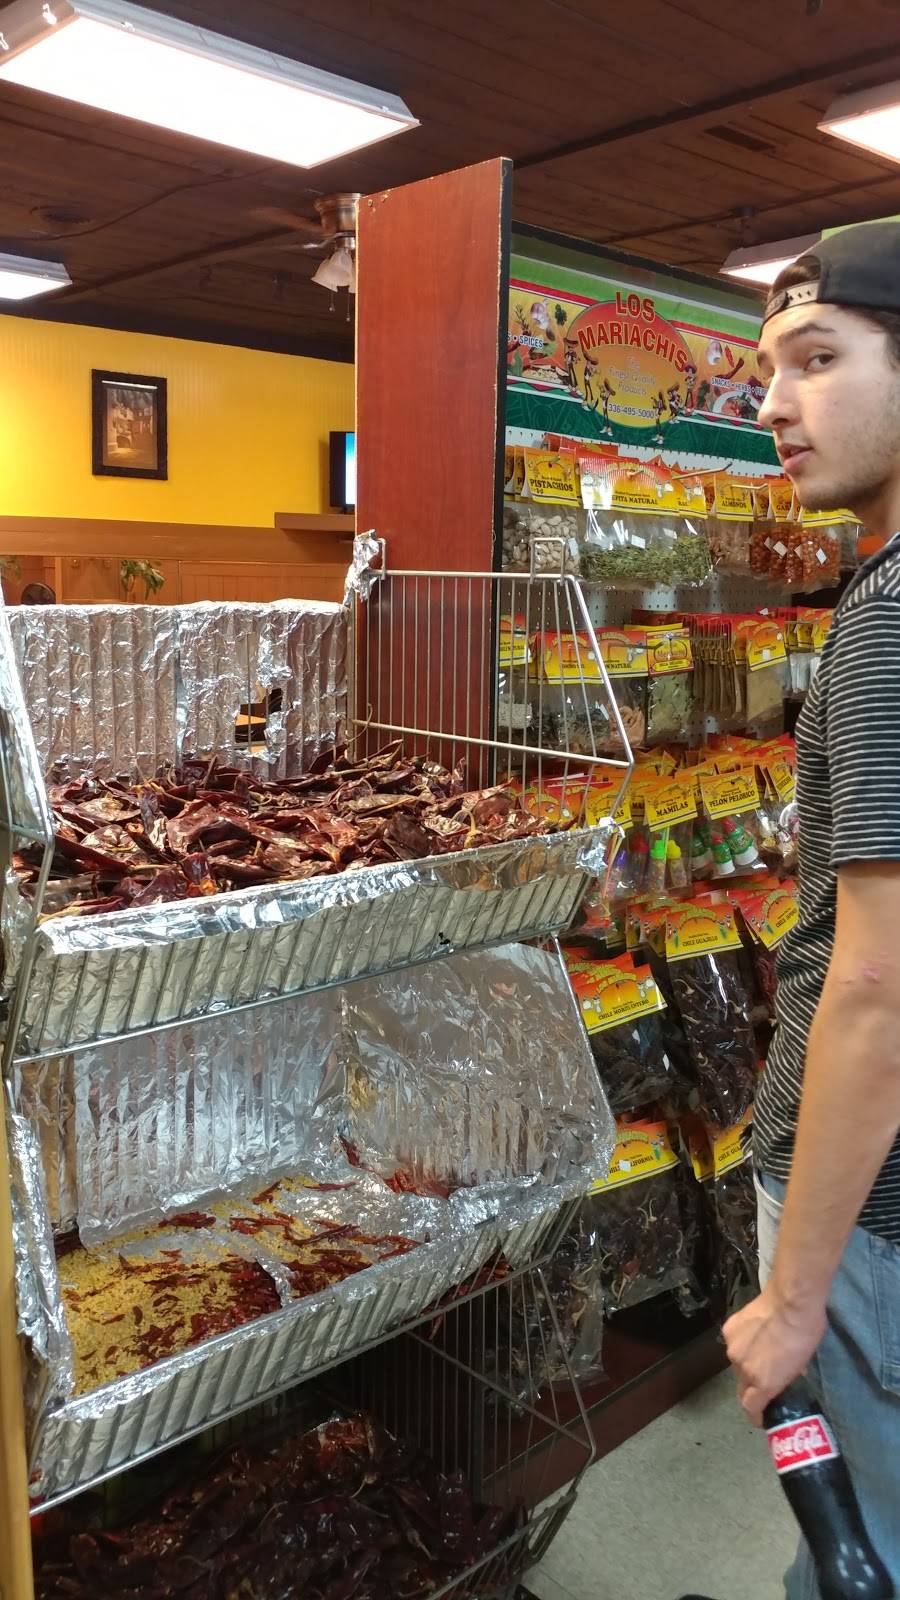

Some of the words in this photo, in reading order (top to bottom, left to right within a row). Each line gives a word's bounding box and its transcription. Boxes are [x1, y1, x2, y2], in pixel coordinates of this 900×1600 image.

[615, 292, 655, 323] LOS
[519, 335, 544, 349] SPICES
[577, 321, 690, 374] MARIACHIS
[530, 478, 574, 492] PISTACHIOS
[629, 496, 658, 506] NATURAL
[655, 801, 689, 817] MAMILAS
